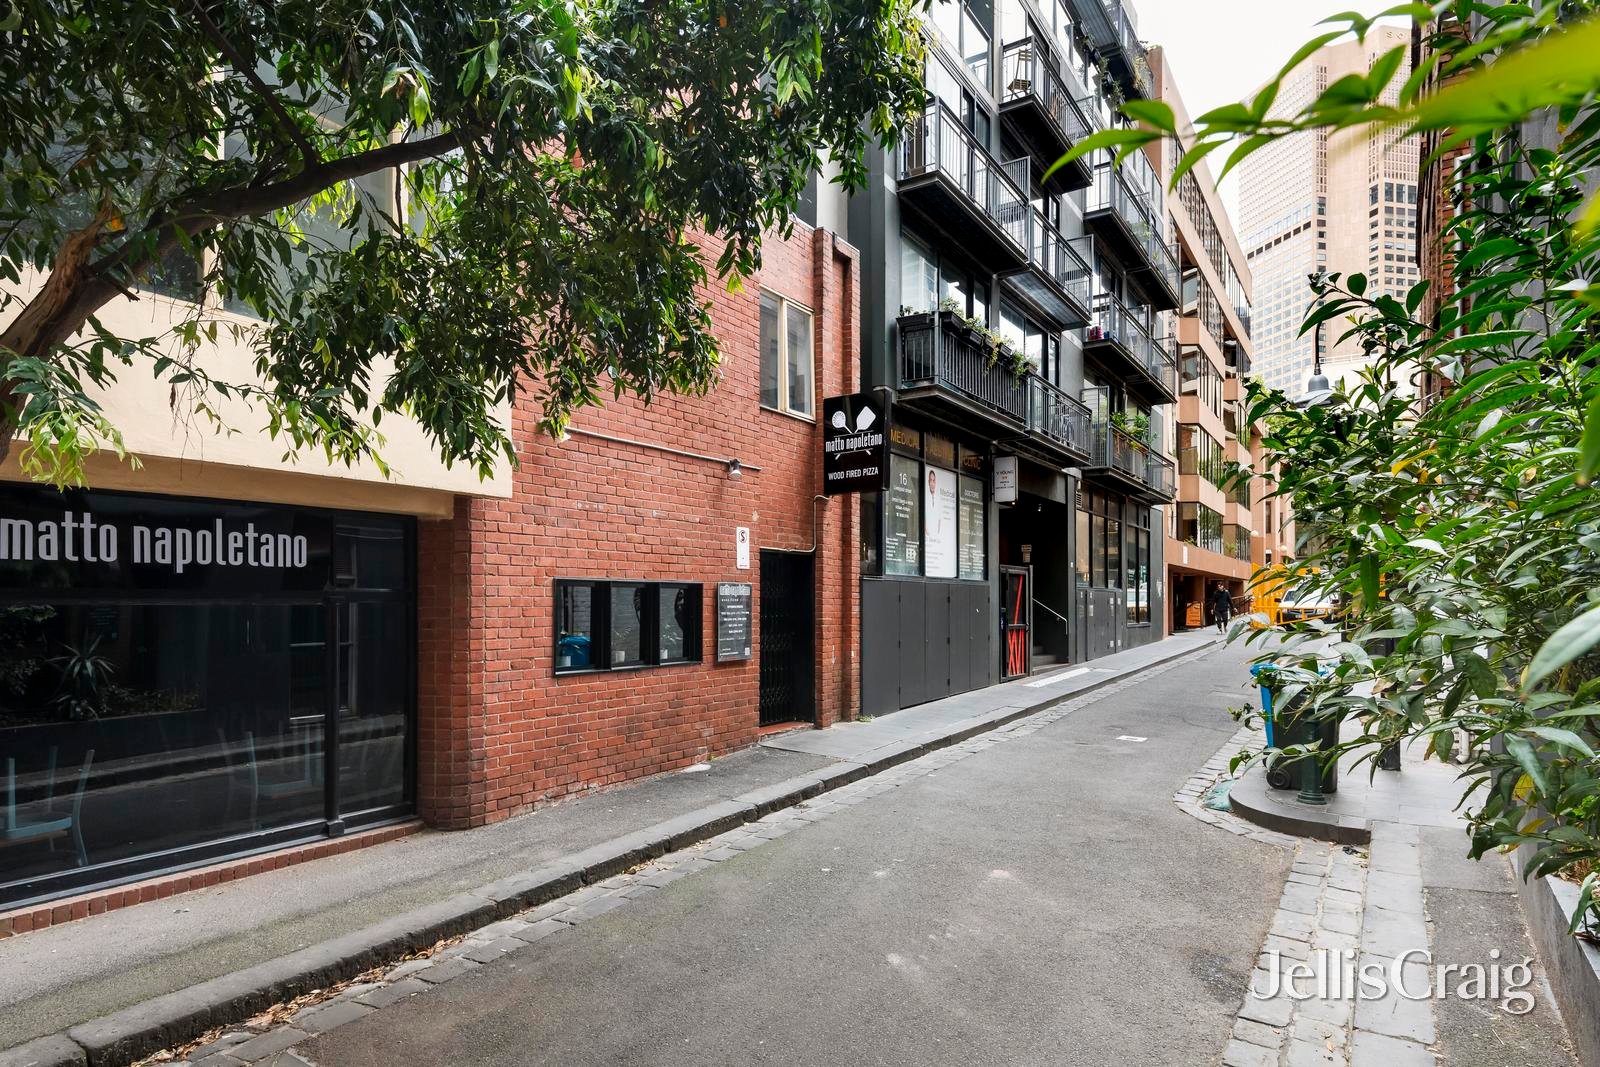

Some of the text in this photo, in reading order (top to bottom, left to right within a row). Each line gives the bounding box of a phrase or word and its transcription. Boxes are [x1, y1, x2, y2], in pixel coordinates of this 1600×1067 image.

[825, 433, 883, 452] matto napoletano
[828, 466, 879, 480] WOOD FIRED PIZZA
[899, 473, 908, 485] 16
[0, 511, 308, 574] matto napoletano
